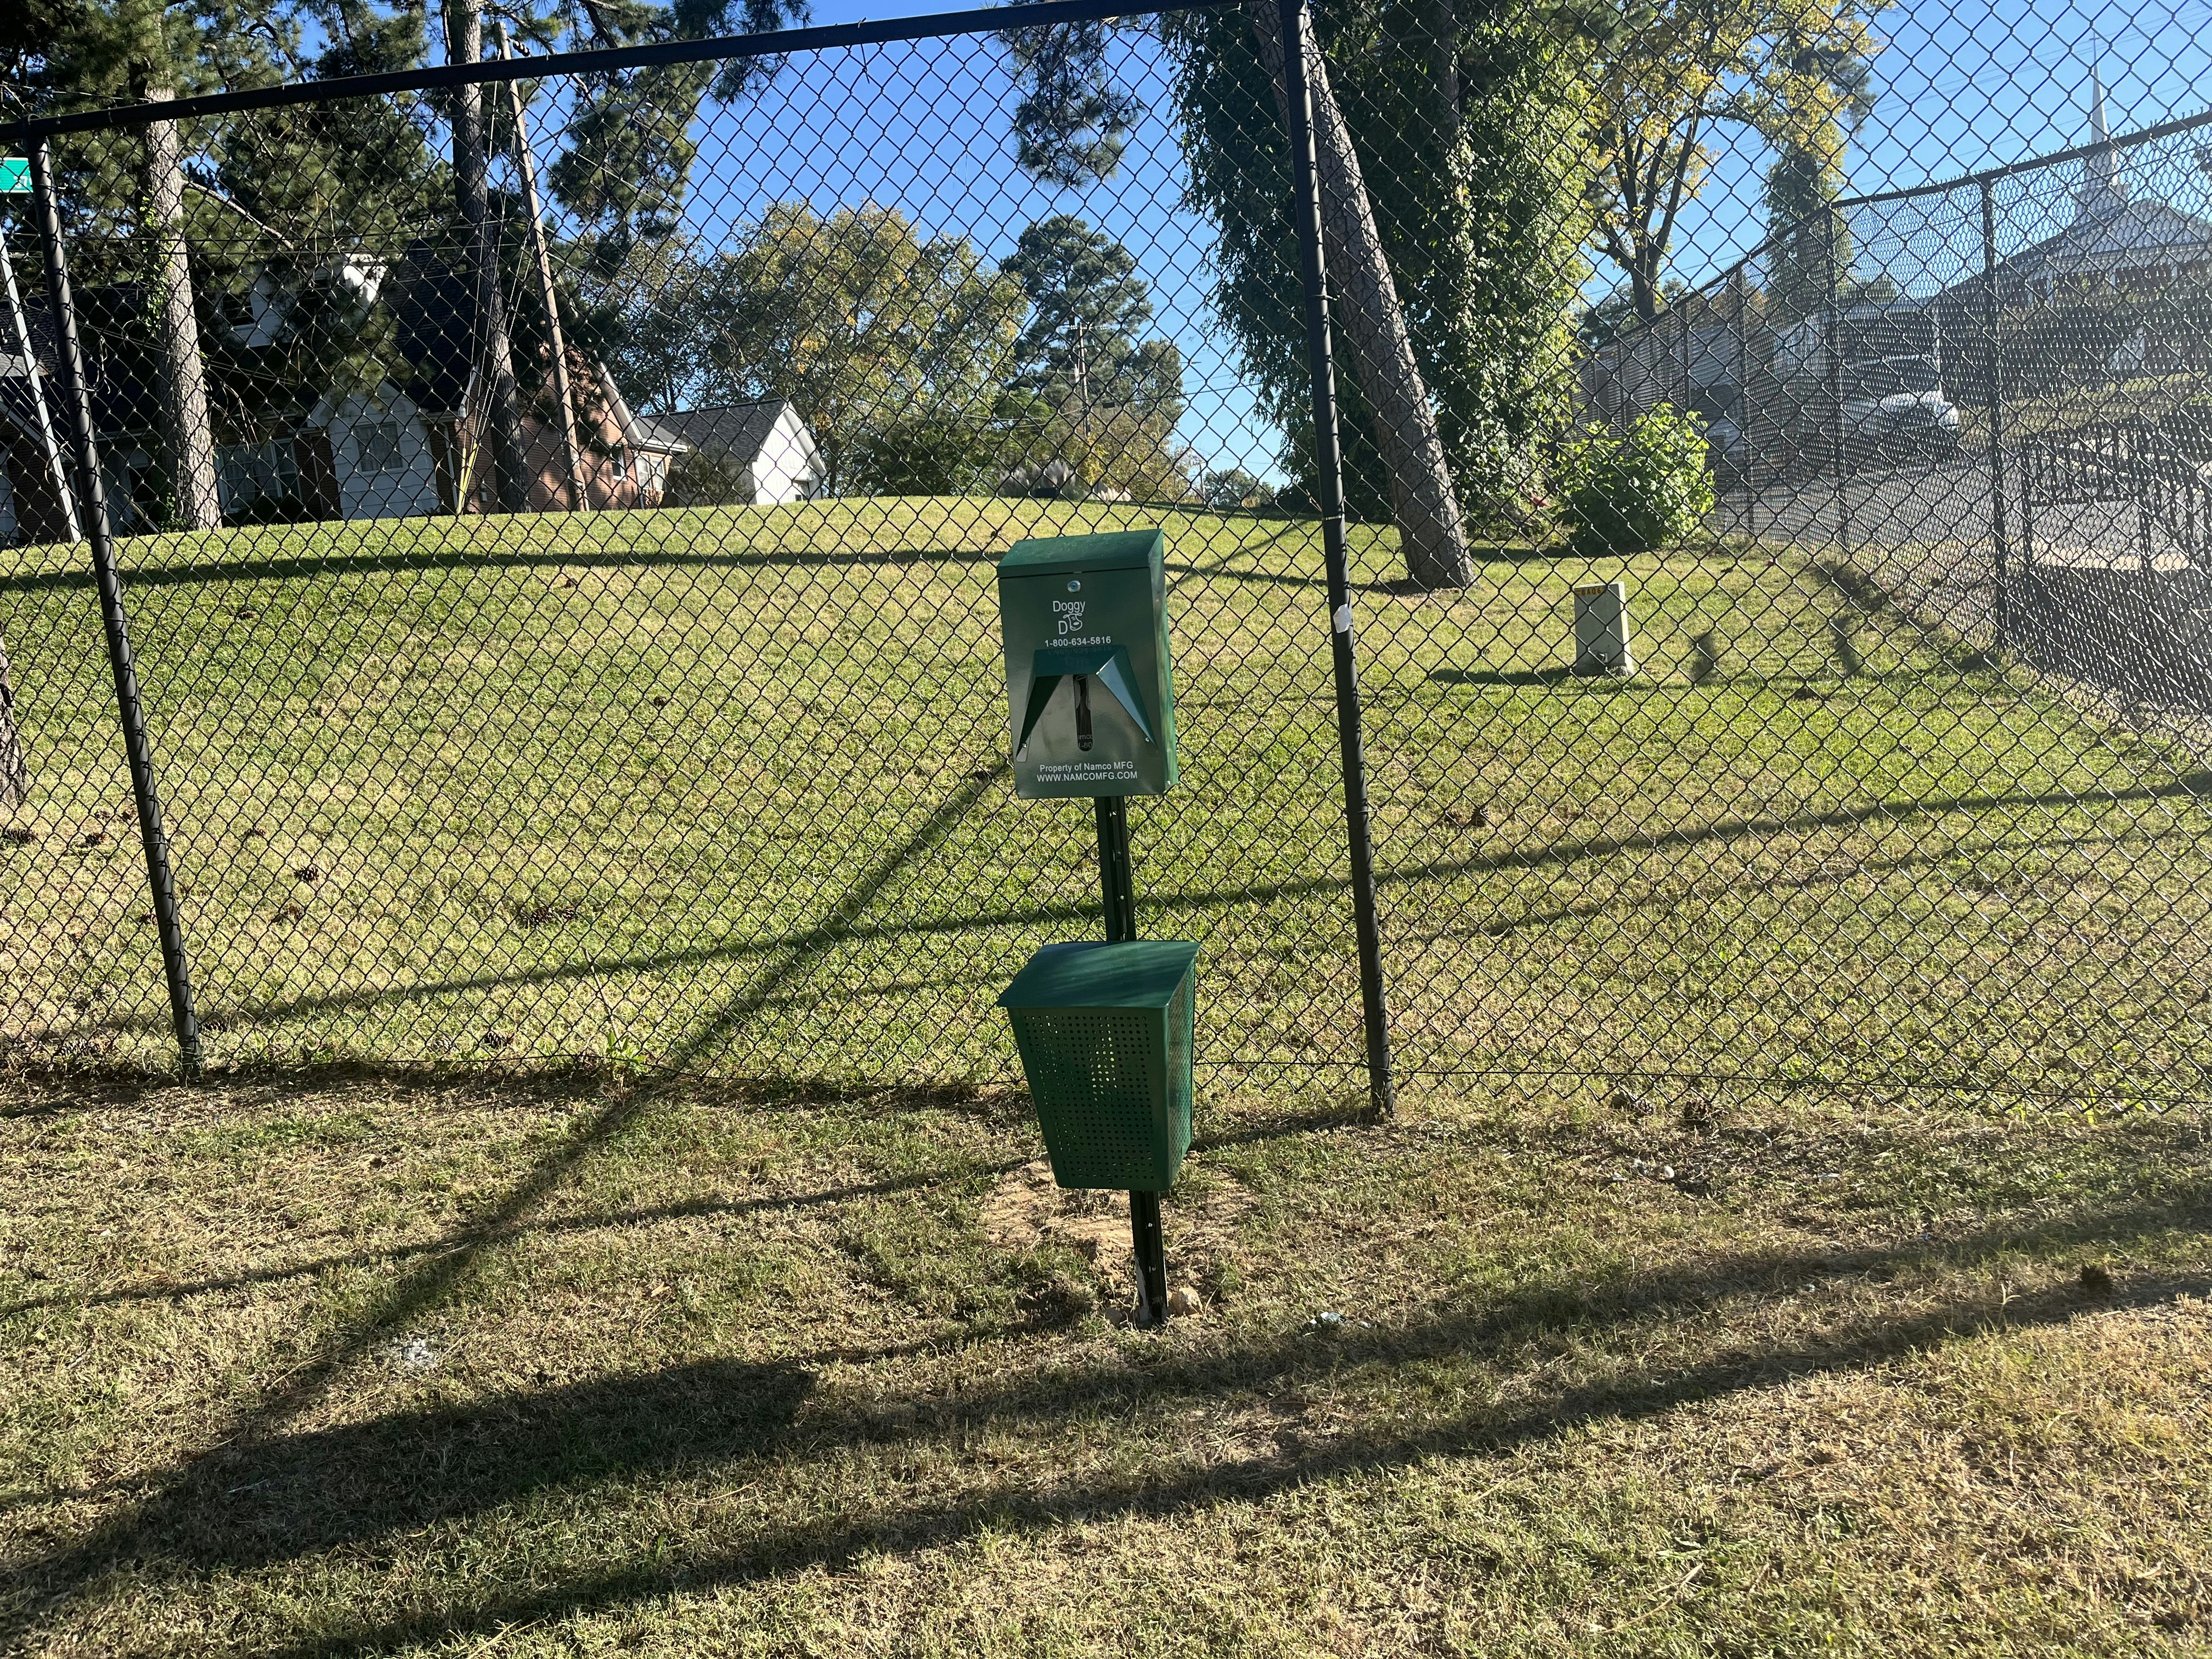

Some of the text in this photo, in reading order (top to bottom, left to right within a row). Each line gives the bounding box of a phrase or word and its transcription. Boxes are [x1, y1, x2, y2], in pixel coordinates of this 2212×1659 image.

[1052, 600, 1086, 613] Doggy
[1045, 636, 1111, 647] 1-800-634-5816
[1040, 761, 1133, 773] Property of Namco MFG
[1036, 771, 1138, 782] WWW.NAMCOMFG.COM
